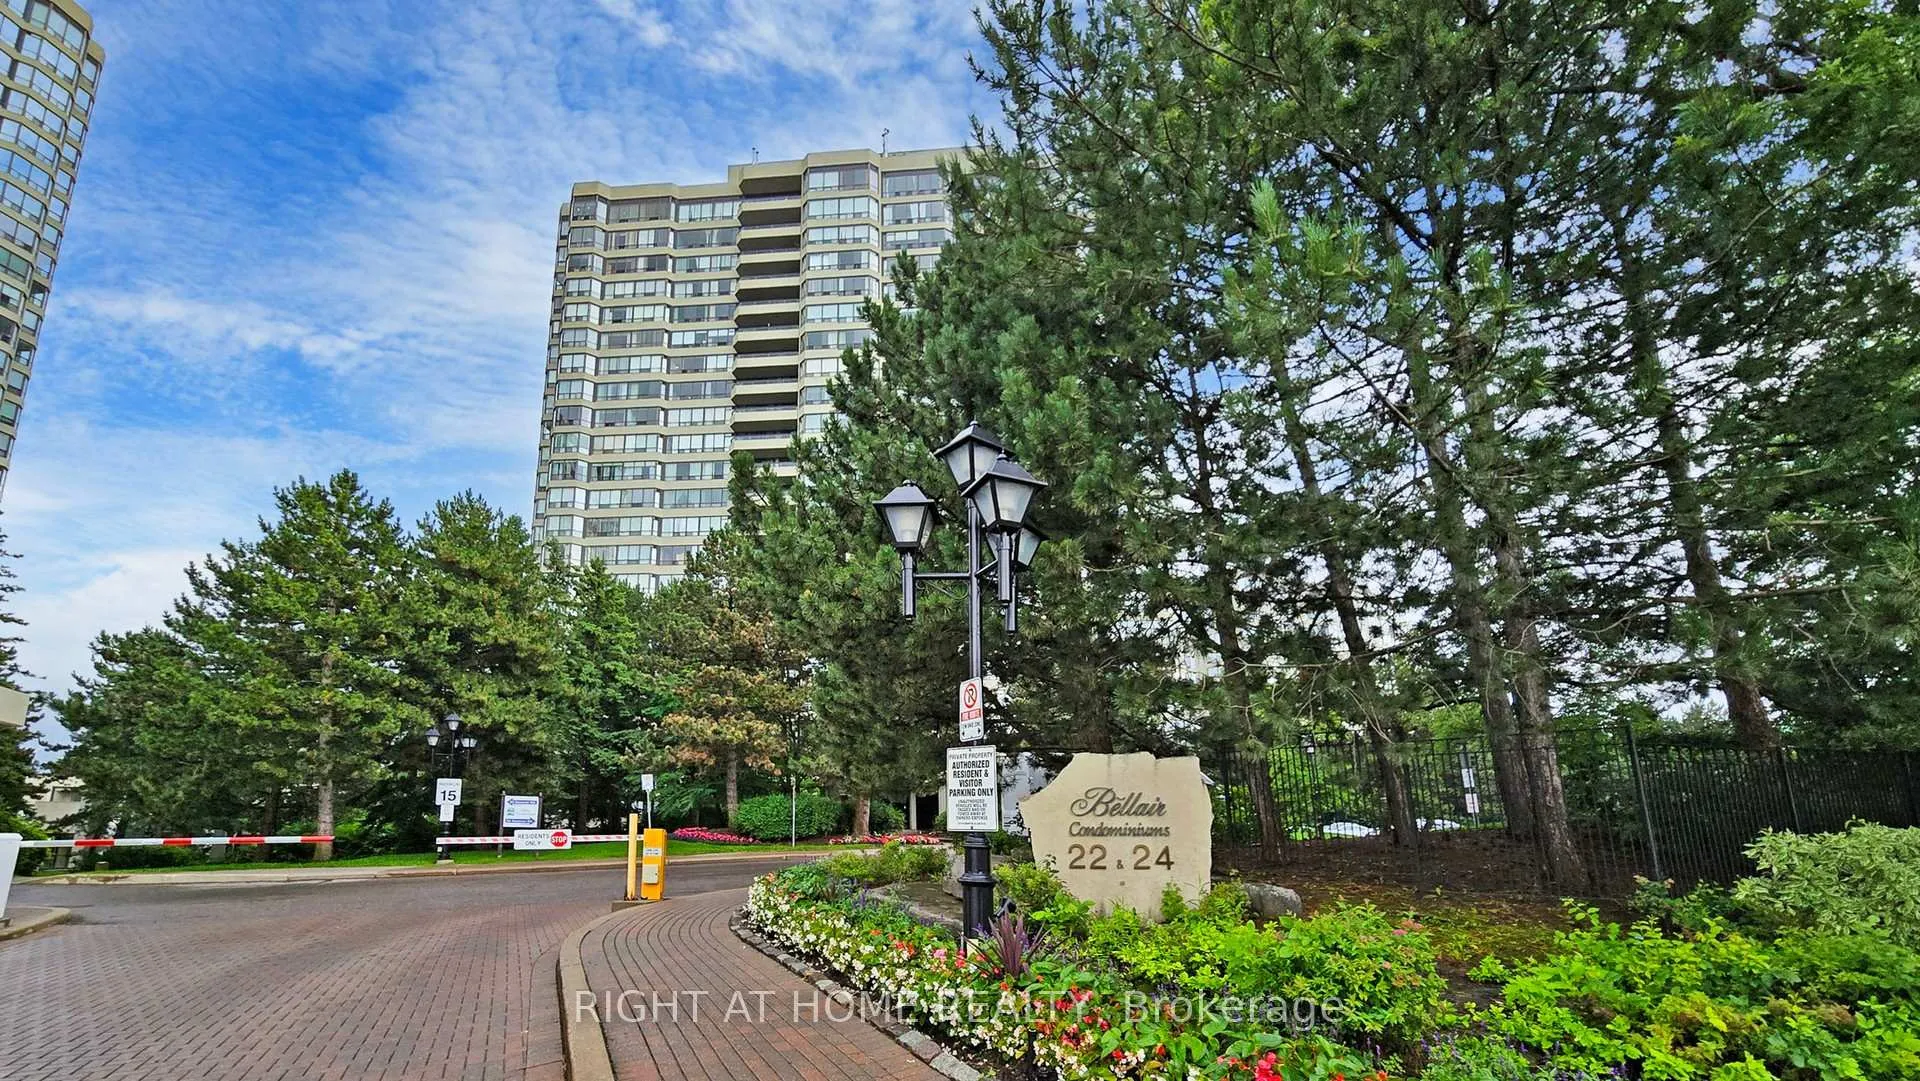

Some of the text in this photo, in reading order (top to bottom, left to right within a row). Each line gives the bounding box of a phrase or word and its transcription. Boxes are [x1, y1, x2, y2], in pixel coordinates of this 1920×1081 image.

[952, 760, 990, 769] AUTHORIZED
[953, 769, 989, 778] RESIDENT &
[959, 779, 983, 787] VISITOR
[440, 790, 457, 801] 15
[949, 787, 994, 797] PARKING ONLY
[1070, 786, 1167, 817] Bellair
[1068, 821, 1170, 837] Condominiums
[551, 835, 567, 843] STOP
[1068, 843, 1175, 870] 22 & 24
